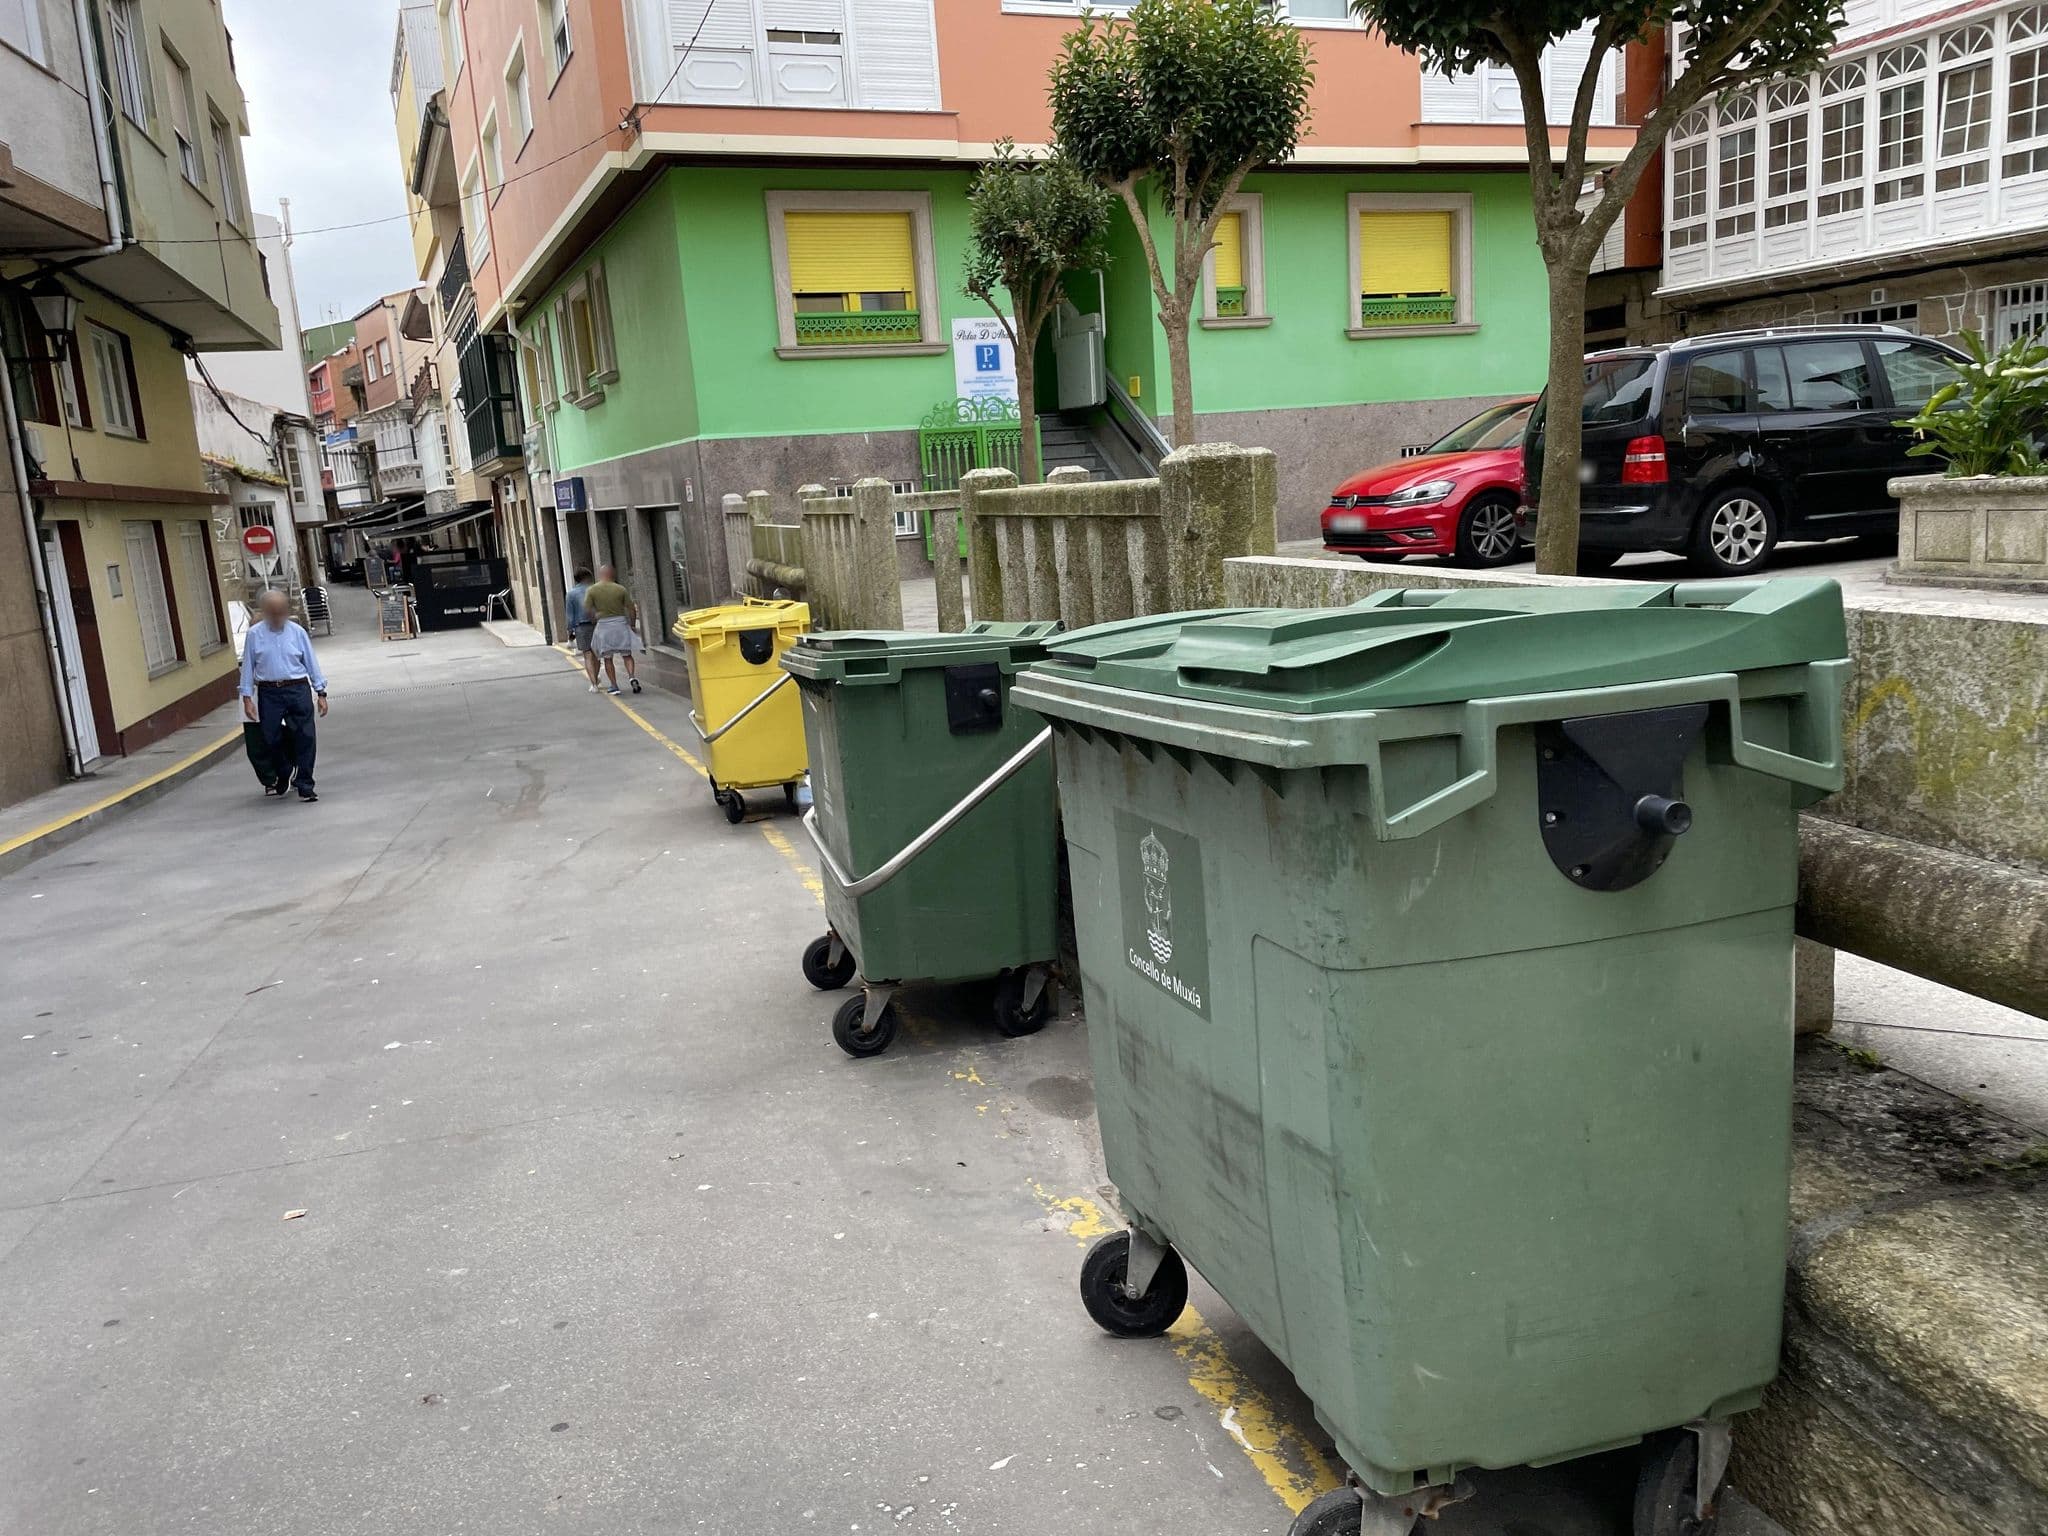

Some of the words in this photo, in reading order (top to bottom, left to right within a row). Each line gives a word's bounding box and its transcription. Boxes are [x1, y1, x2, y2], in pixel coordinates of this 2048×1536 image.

[983, 347, 993, 362] P
[1129, 948, 1159, 982] Concello
[1161, 968, 1172, 990] de
[1173, 976, 1201, 1009] Muxía
